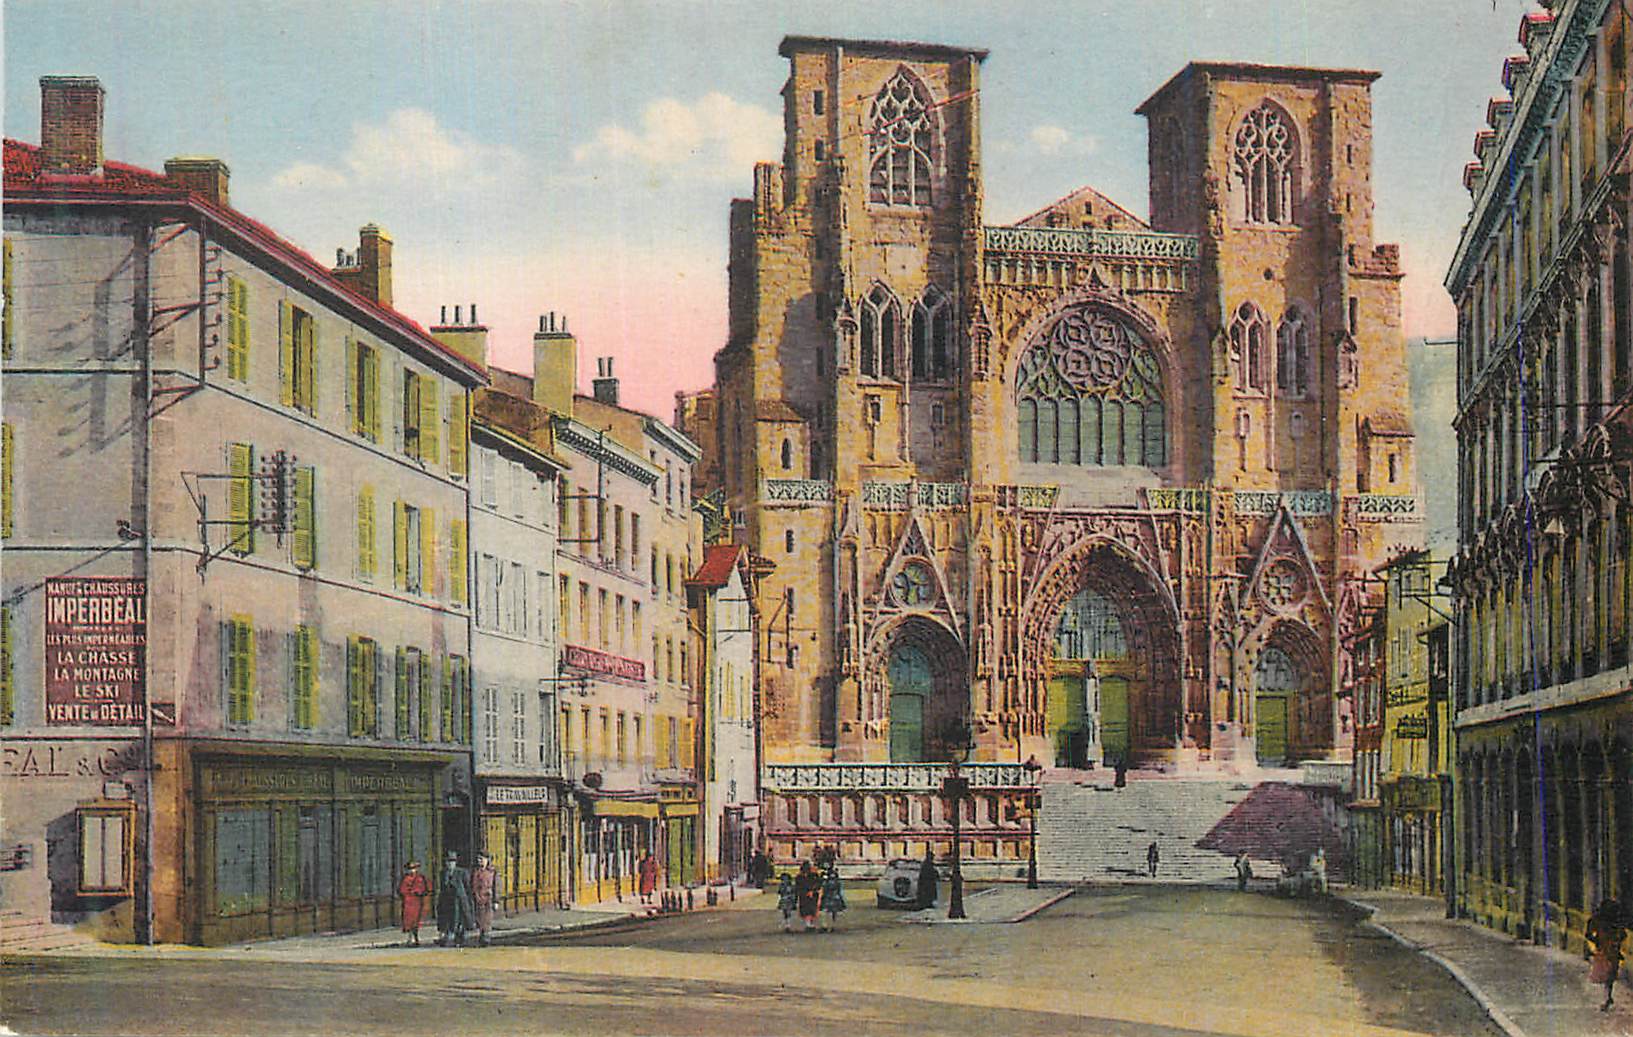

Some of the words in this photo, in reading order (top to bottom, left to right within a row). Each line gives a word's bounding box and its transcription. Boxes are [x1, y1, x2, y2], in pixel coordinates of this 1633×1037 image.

[58, 651, 74, 664] LA
[79, 651, 136, 664] CHASSE
[55, 667, 69, 680] LA
[74, 667, 140, 681] MONTAGNE
[75, 685, 91, 698] LE
[95, 685, 119, 698] SKI
[49, 704, 89, 720] VENTE
